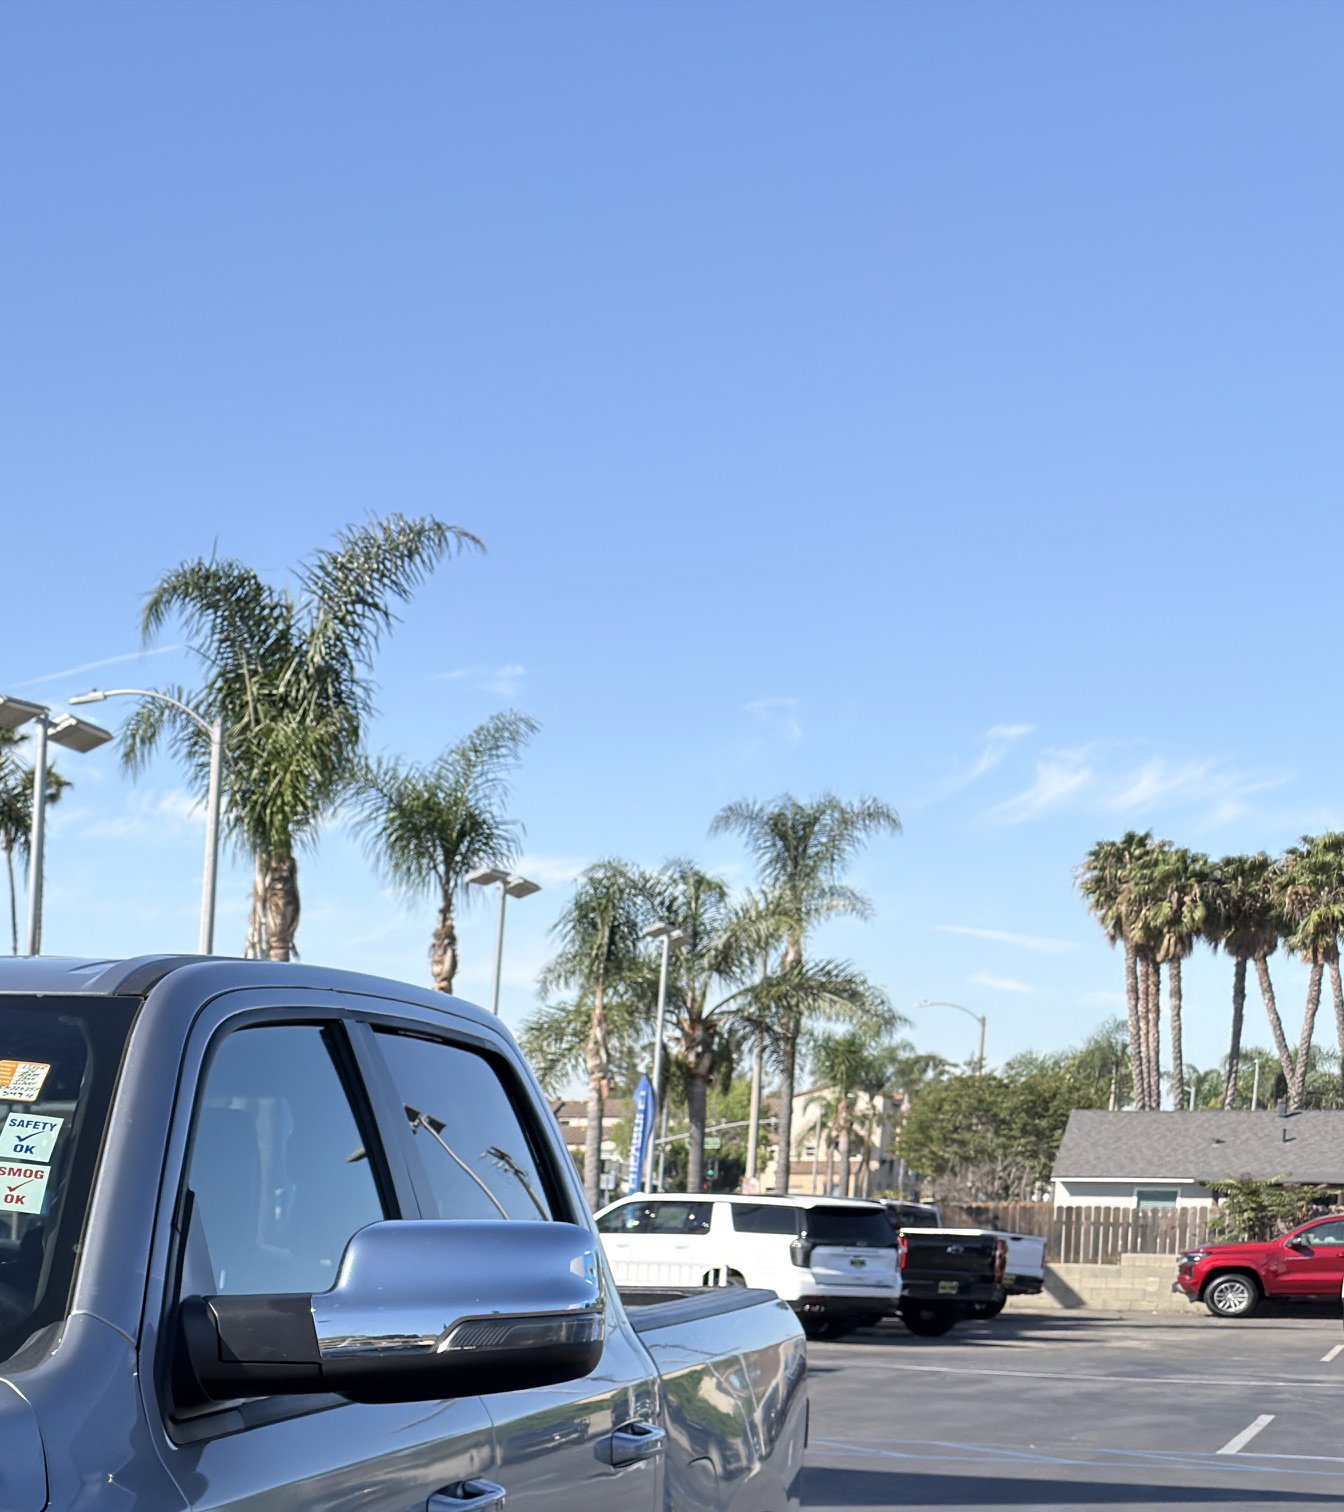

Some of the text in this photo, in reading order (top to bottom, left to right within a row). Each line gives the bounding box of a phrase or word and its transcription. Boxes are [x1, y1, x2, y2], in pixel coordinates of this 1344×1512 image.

[8, 1118, 57, 1132] SAFETY
[13, 1143, 36, 1155] OK
[4, 1193, 26, 1205] OK
